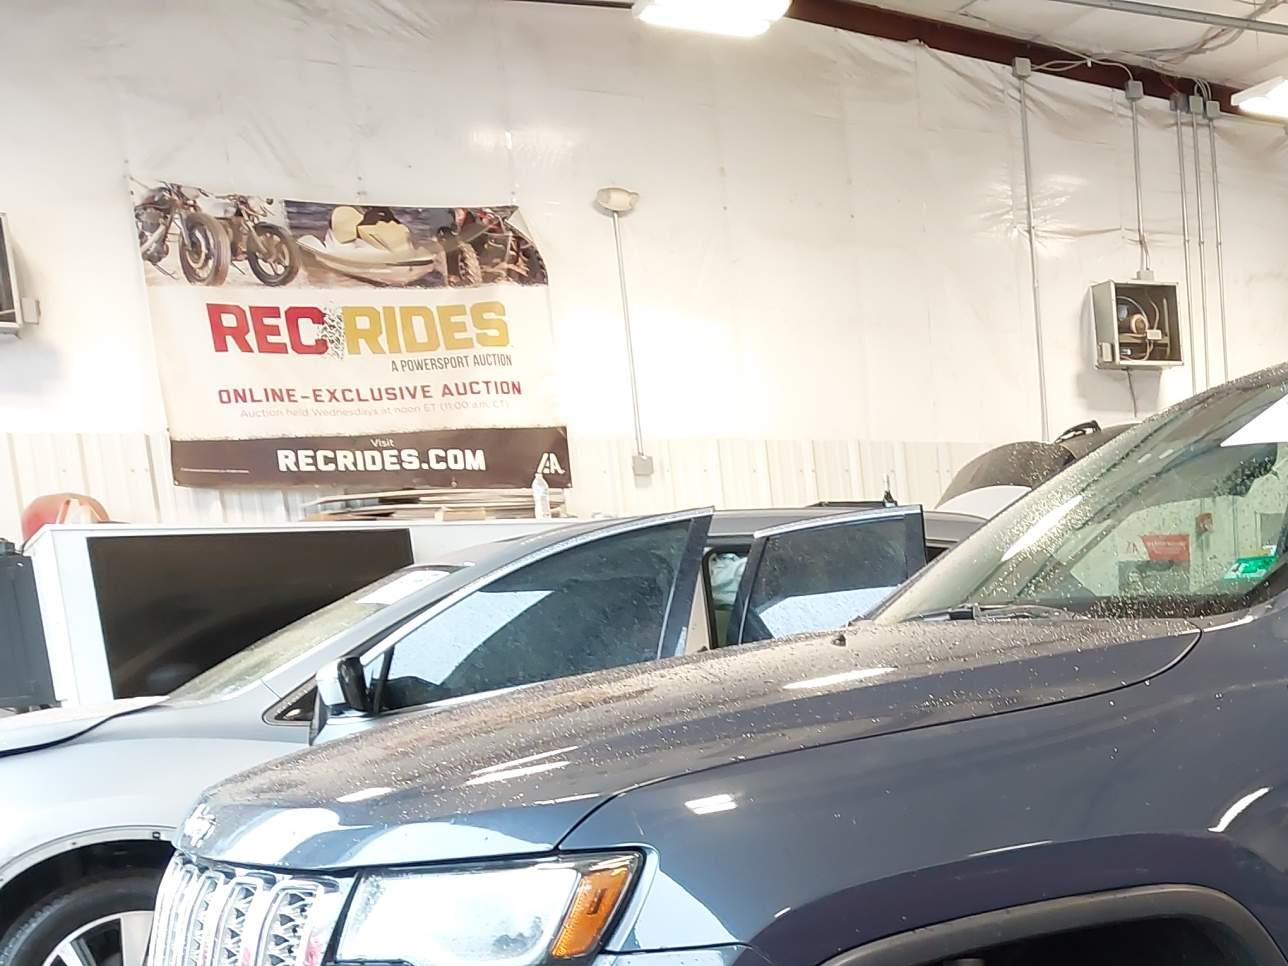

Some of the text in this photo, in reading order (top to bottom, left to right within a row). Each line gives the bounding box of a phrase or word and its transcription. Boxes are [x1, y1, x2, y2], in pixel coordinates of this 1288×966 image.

[206, 300, 511, 355] REC RIDES
[391, 353, 513, 372] A POWERSPORT AUCTION
[218, 380, 523, 405] ONLINE-EXCLUSIVE AUCTION
[371, 438, 395, 448] Visit
[277, 448, 486, 472] RECRIDES.COM
